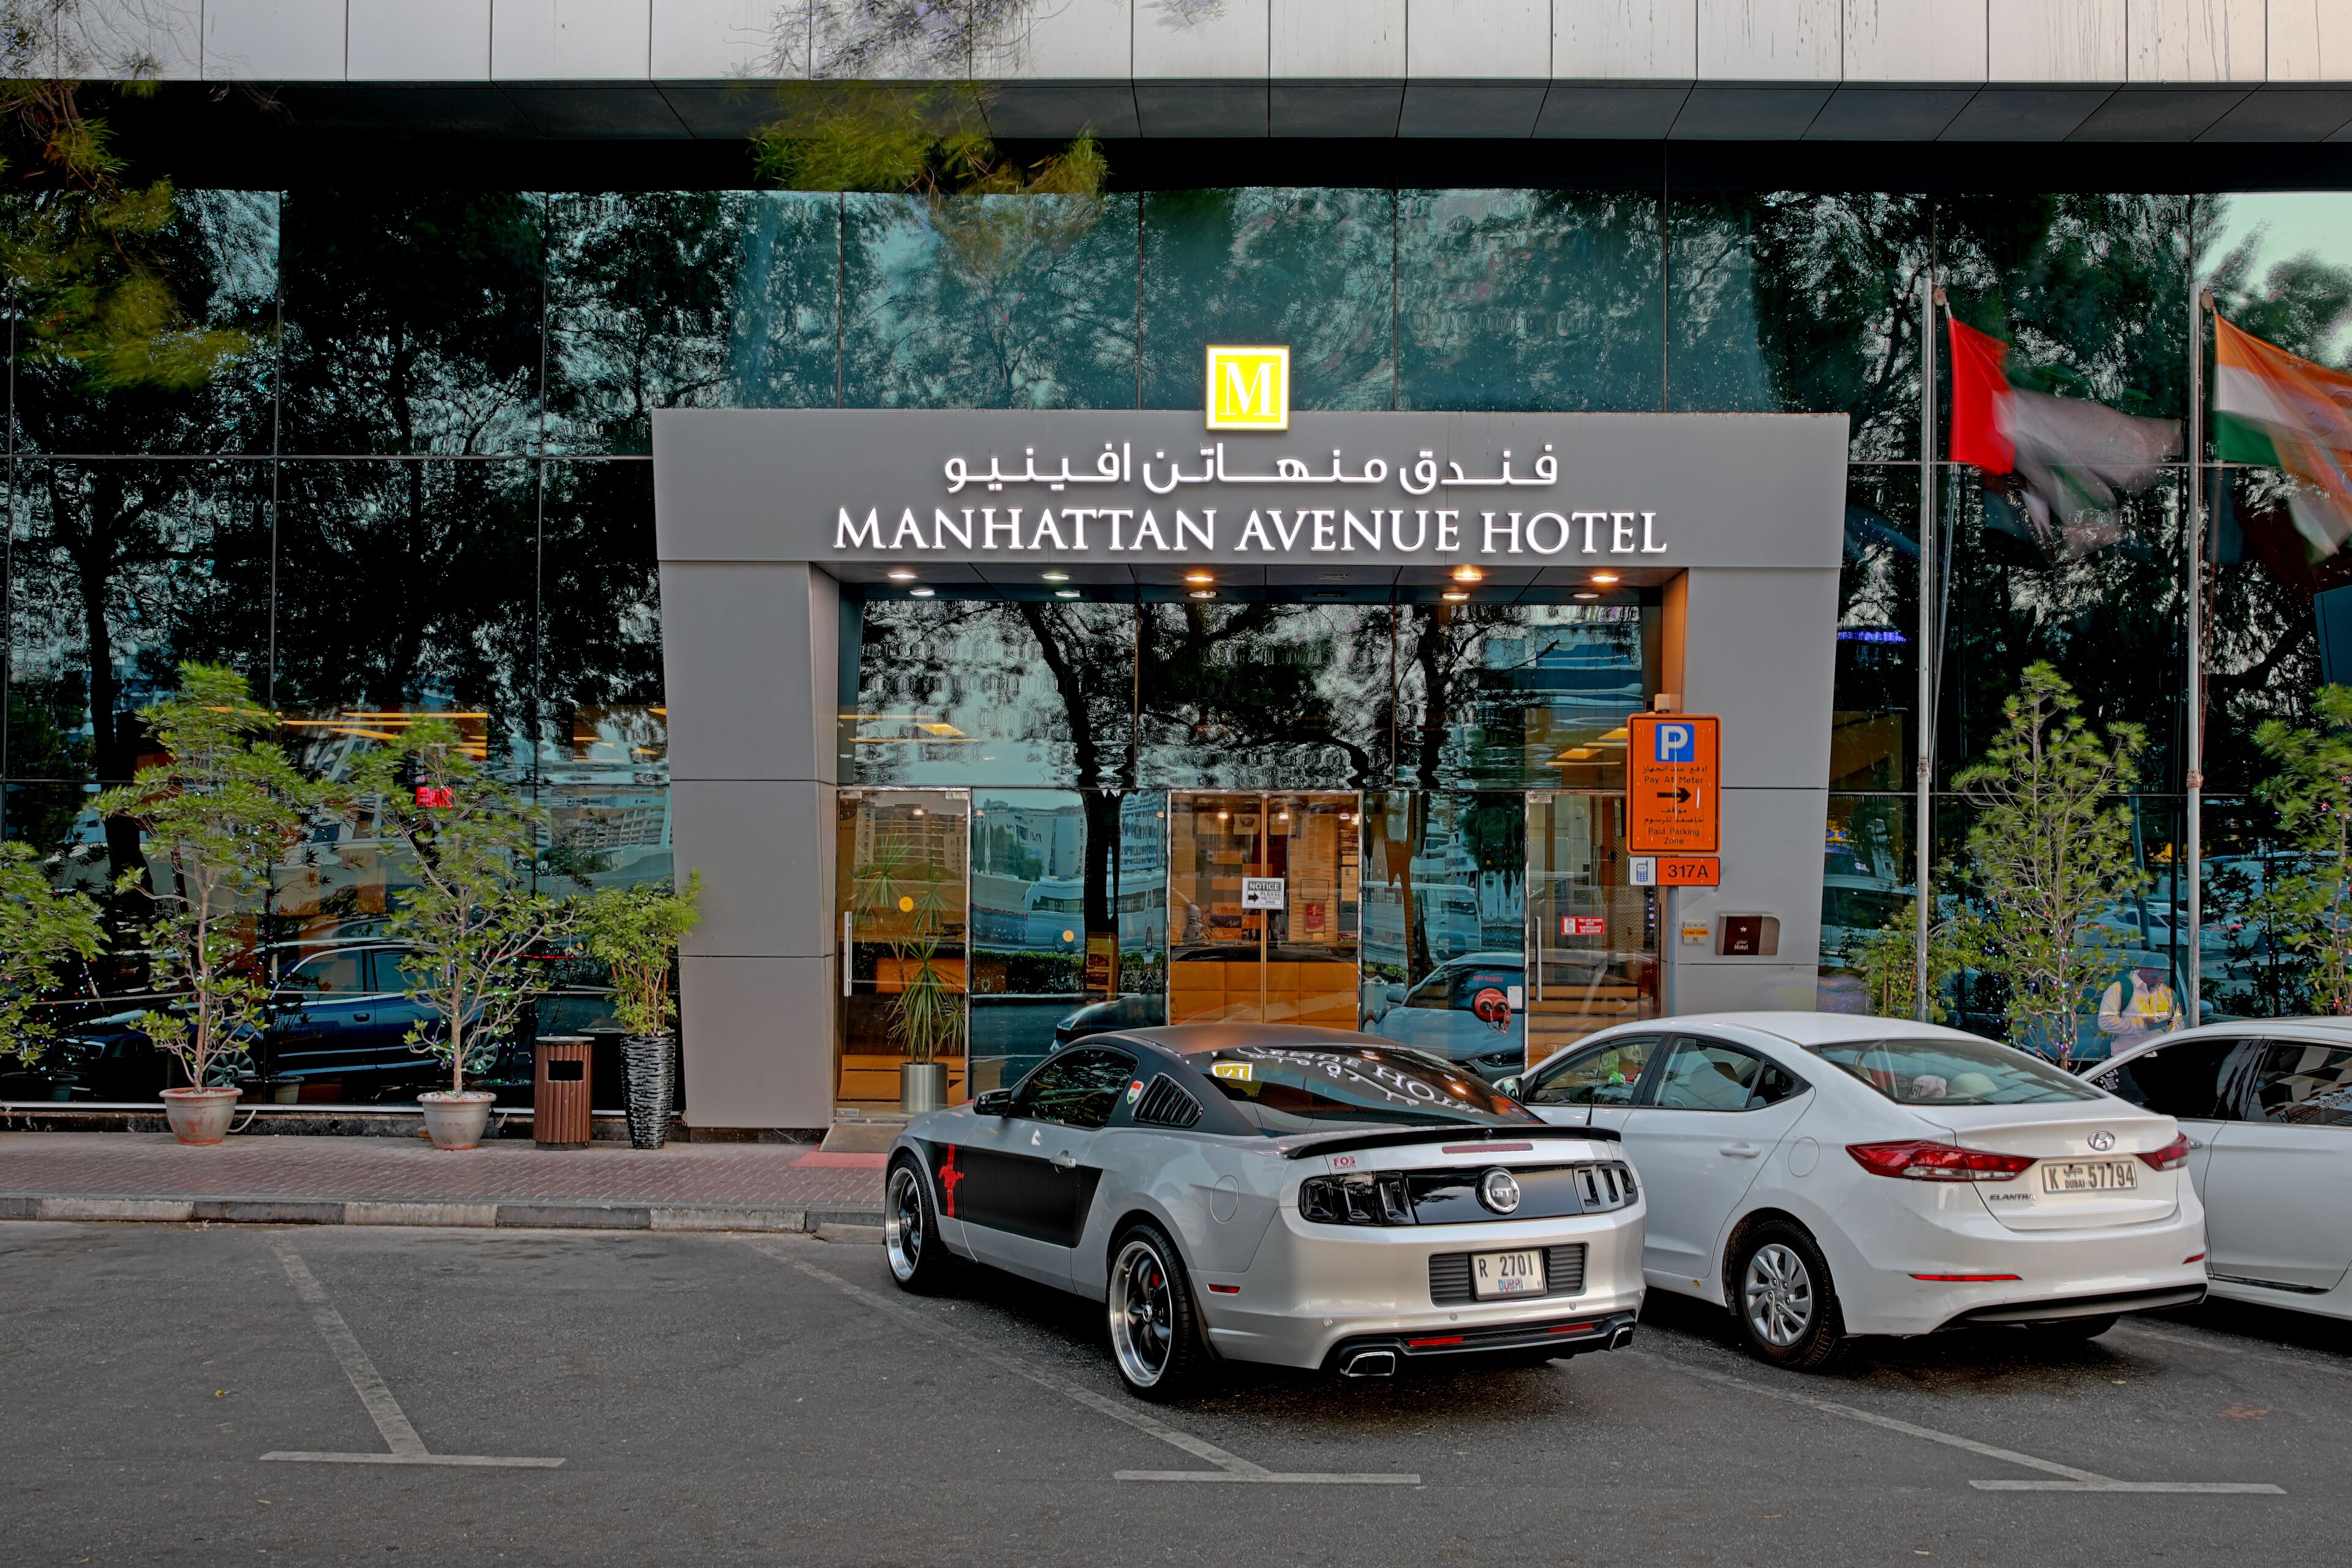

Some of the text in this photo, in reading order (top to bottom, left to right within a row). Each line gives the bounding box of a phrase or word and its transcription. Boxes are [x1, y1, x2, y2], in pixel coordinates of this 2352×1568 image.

[1219, 363, 1278, 415] M
[944, 442, 1558, 494] فندق منهاتن افينيو
[833, 507, 1667, 554] MANHATTAN AVENUE HOTEL
[1661, 725, 1689, 760] P
[1644, 775, 1659, 784] Pay
[1670, 827, 1700, 837] Parking
[1667, 864, 1709, 878] 317A
[1250, 882, 1280, 891] NOTICE
[2049, 1164, 2135, 1191] K 57794
[2064, 1178, 2086, 1190] DUBAI
[1492, 1186, 1512, 1198] GT
[1989, 1193, 2037, 1202] ELANTRA
[1478, 1253, 1534, 1278] R 2701
